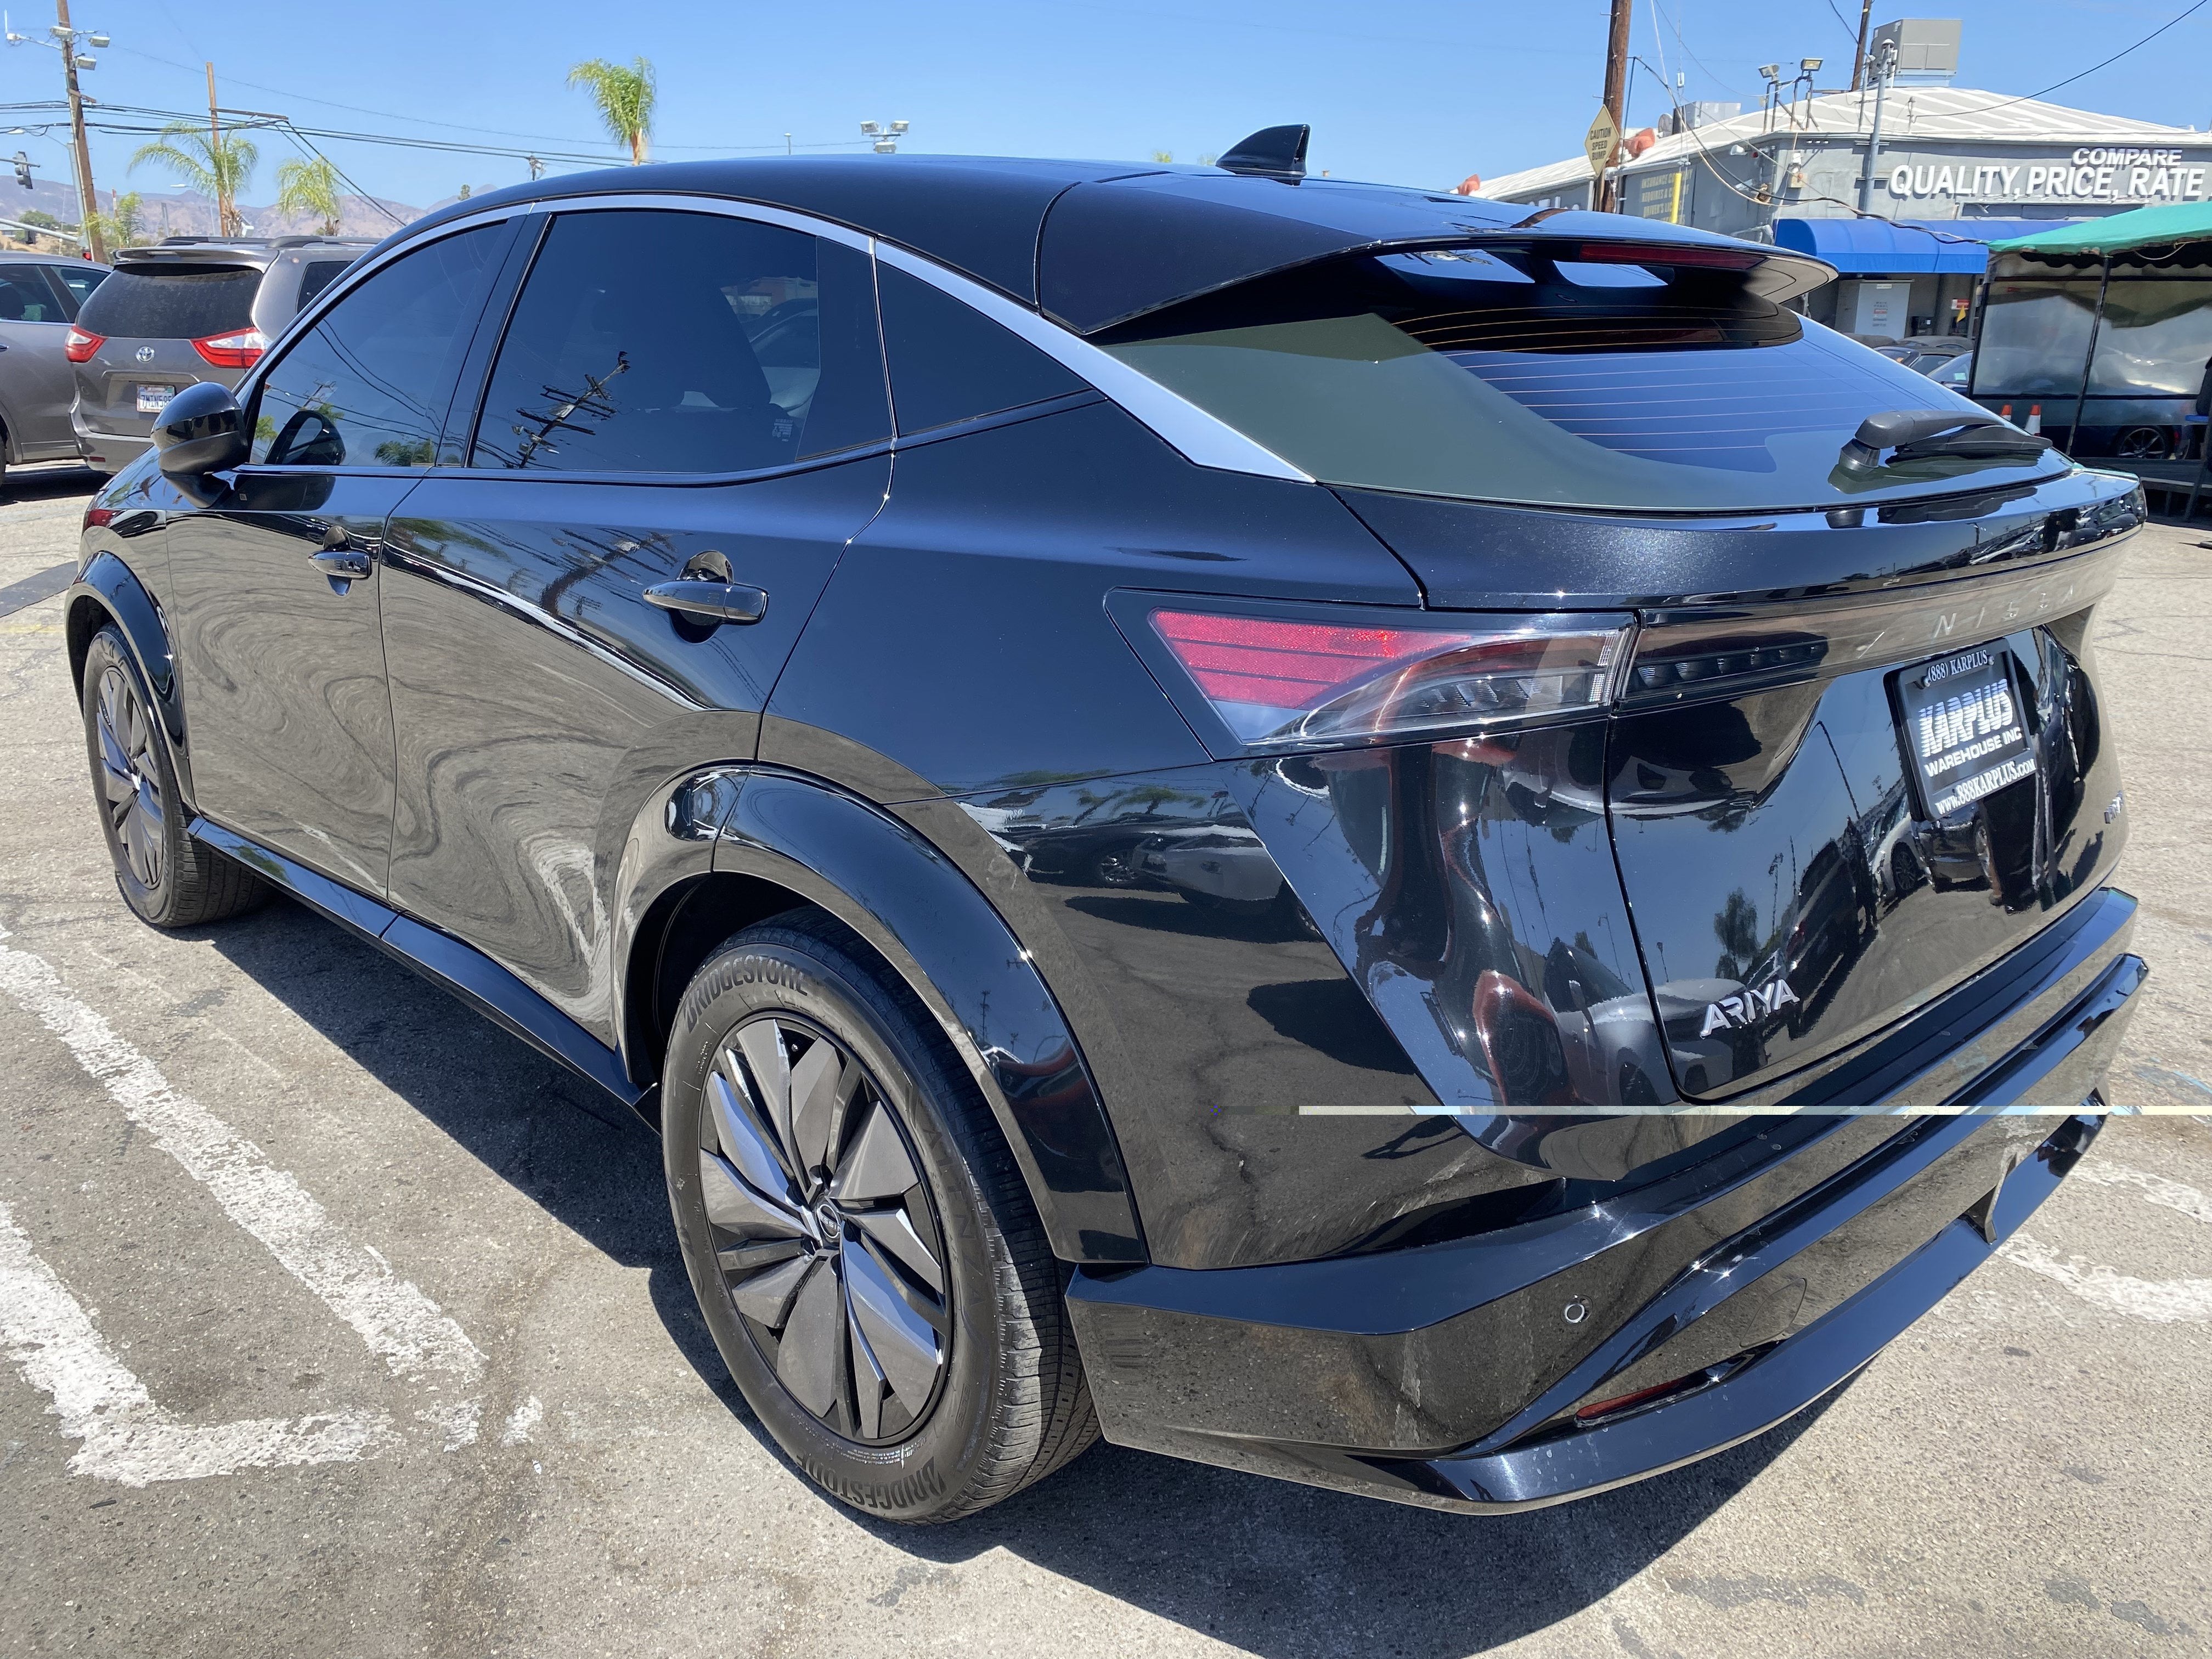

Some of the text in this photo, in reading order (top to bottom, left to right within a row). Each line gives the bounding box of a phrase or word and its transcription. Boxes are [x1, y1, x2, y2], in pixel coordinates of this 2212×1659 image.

[1590, 127, 1612, 140] CAUTION
[1592, 140, 1607, 150] SPEED
[1592, 150, 1606, 160] BUMP
[2073, 148, 2182, 166] COMPARE
[1890, 164, 2206, 201] QUALITY, PRICE, RATE
[1927, 650, 1989, 682] (888) KARPLUS
[1918, 678, 2013, 758] KARPLUS
[1924, 726, 2023, 777] WAREHOUSE INC
[684, 954, 808, 1035] BRIDGESTONE
[1700, 979, 1801, 1039] ARIYA
[796, 1456, 948, 1510] BRIDGESTONE
